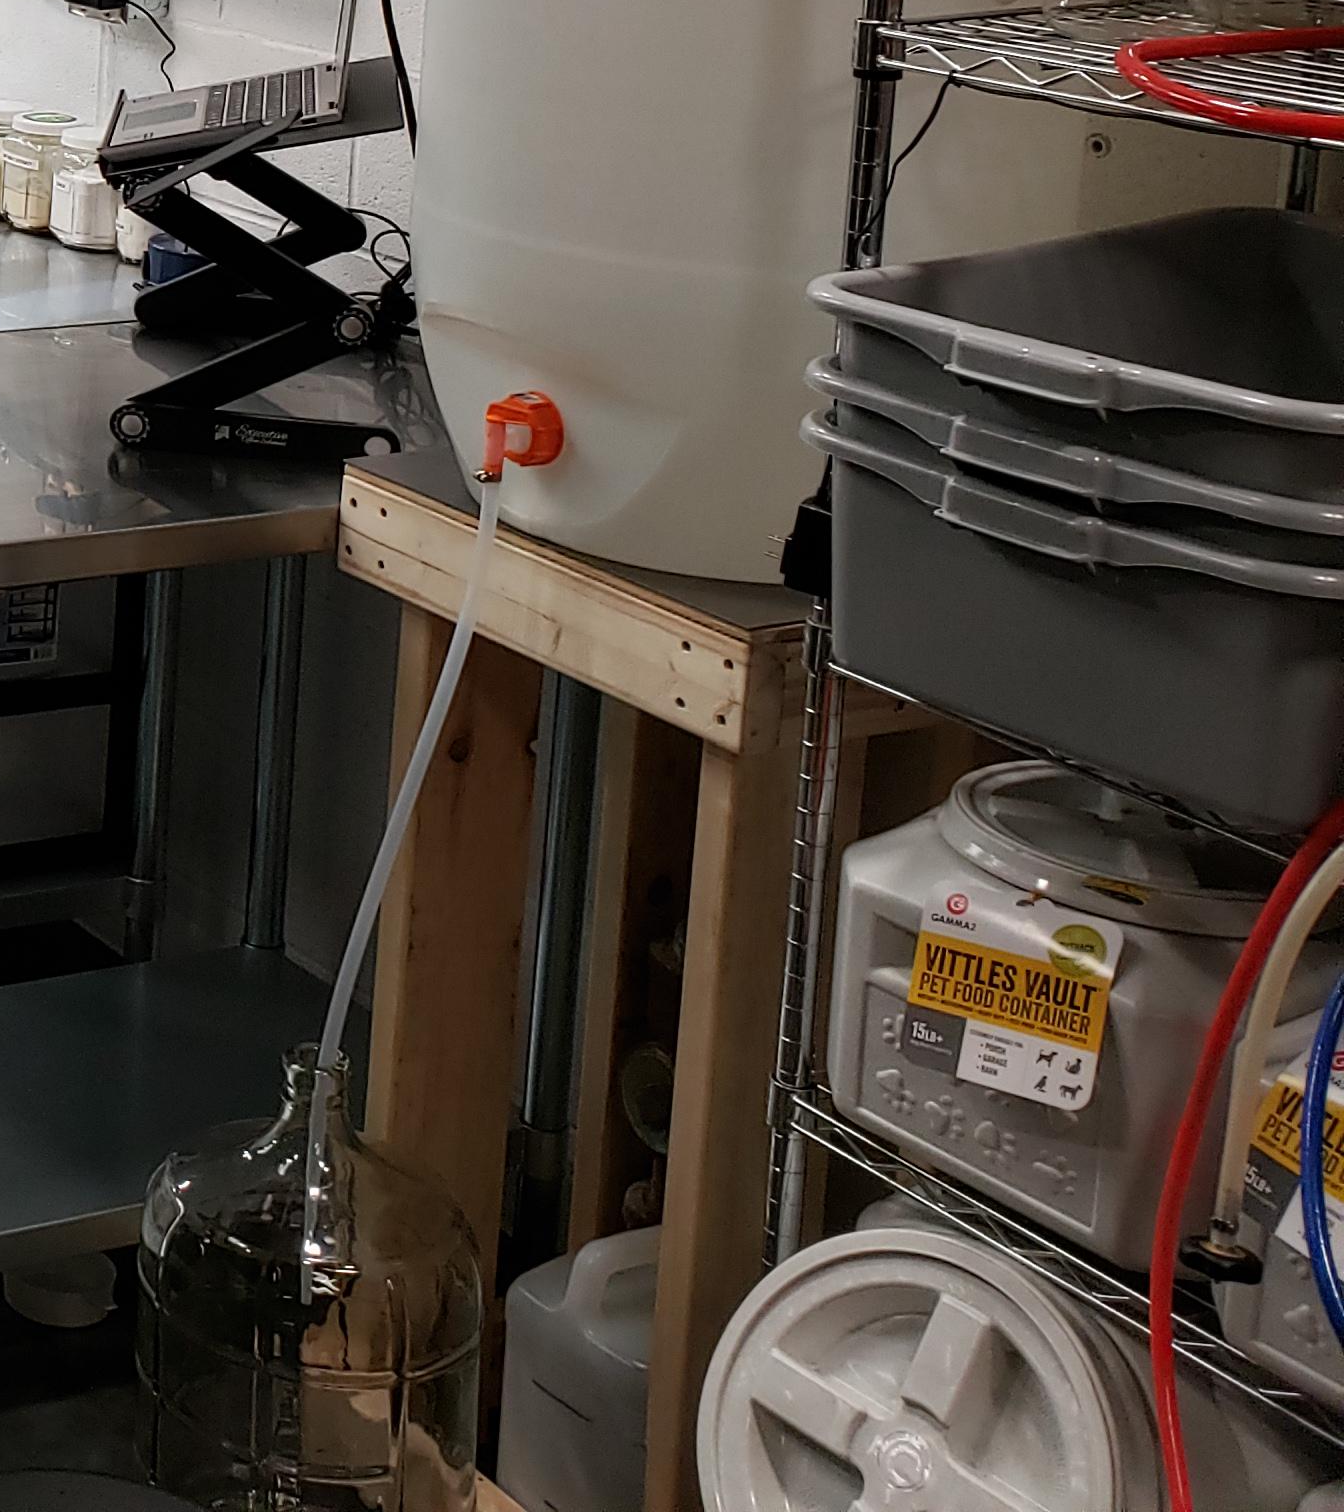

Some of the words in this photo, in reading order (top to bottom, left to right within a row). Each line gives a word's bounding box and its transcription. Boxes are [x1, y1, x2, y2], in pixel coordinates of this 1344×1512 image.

[931, 913, 977, 932] GAMMA2
[925, 942, 1018, 993] VITTLES
[1025, 969, 1097, 1014] VAULT
[919, 972, 951, 996] PET
[952, 979, 996, 1009] FOOD
[999, 992, 1091, 1036] CONTAINER
[1262, 1114, 1298, 1147] PET
